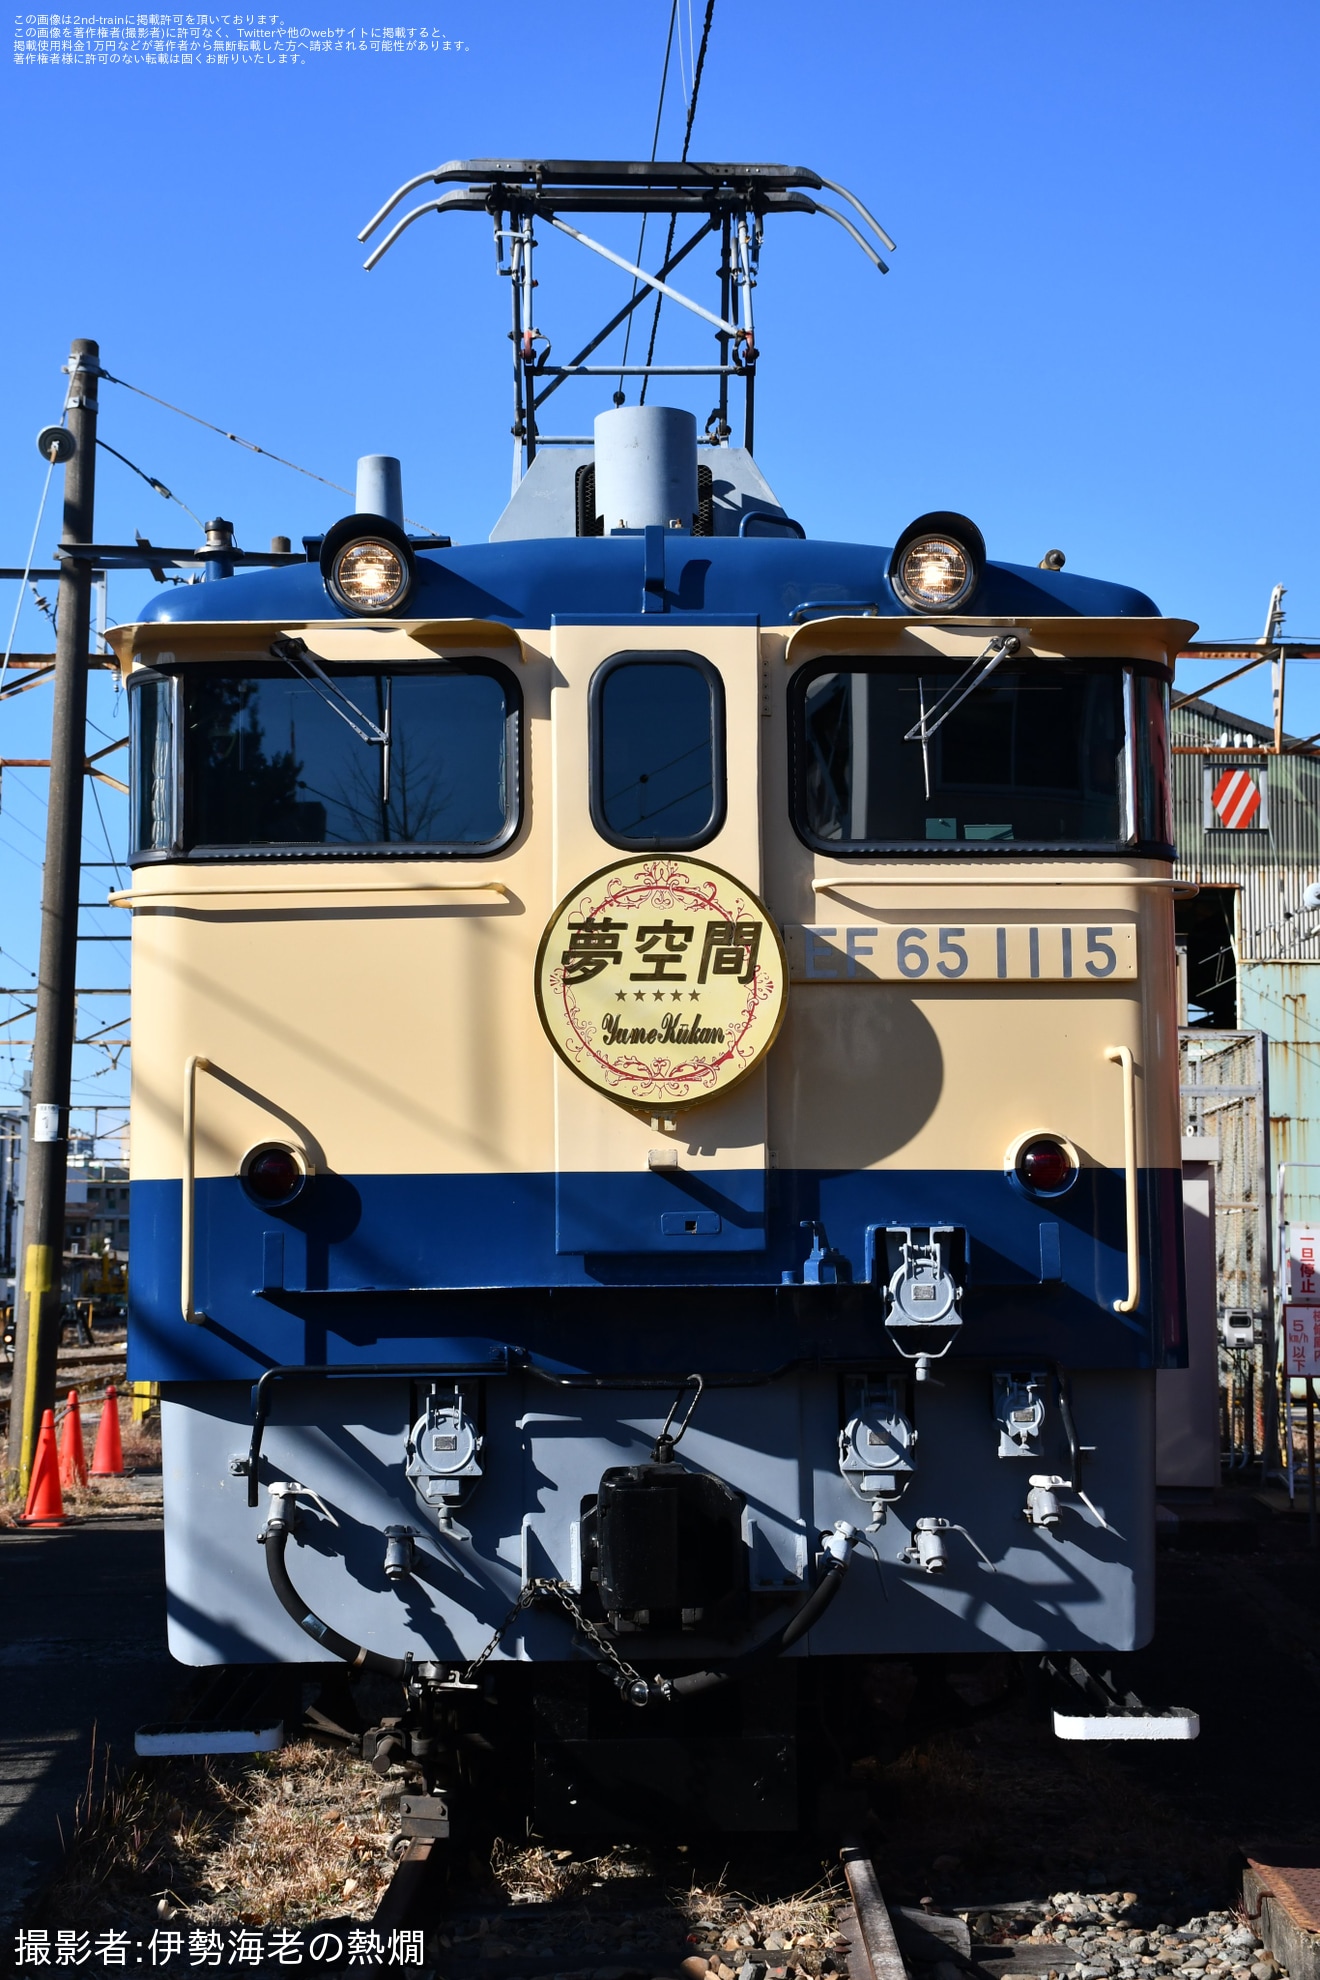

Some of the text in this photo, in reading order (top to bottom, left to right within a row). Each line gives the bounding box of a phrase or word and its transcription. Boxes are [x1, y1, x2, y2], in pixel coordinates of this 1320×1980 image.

[561, 917, 763, 985] 夢空間
[601, 1012, 658, 1046] Yume
[1300, 1237, 1315, 1293] 一旦停止
